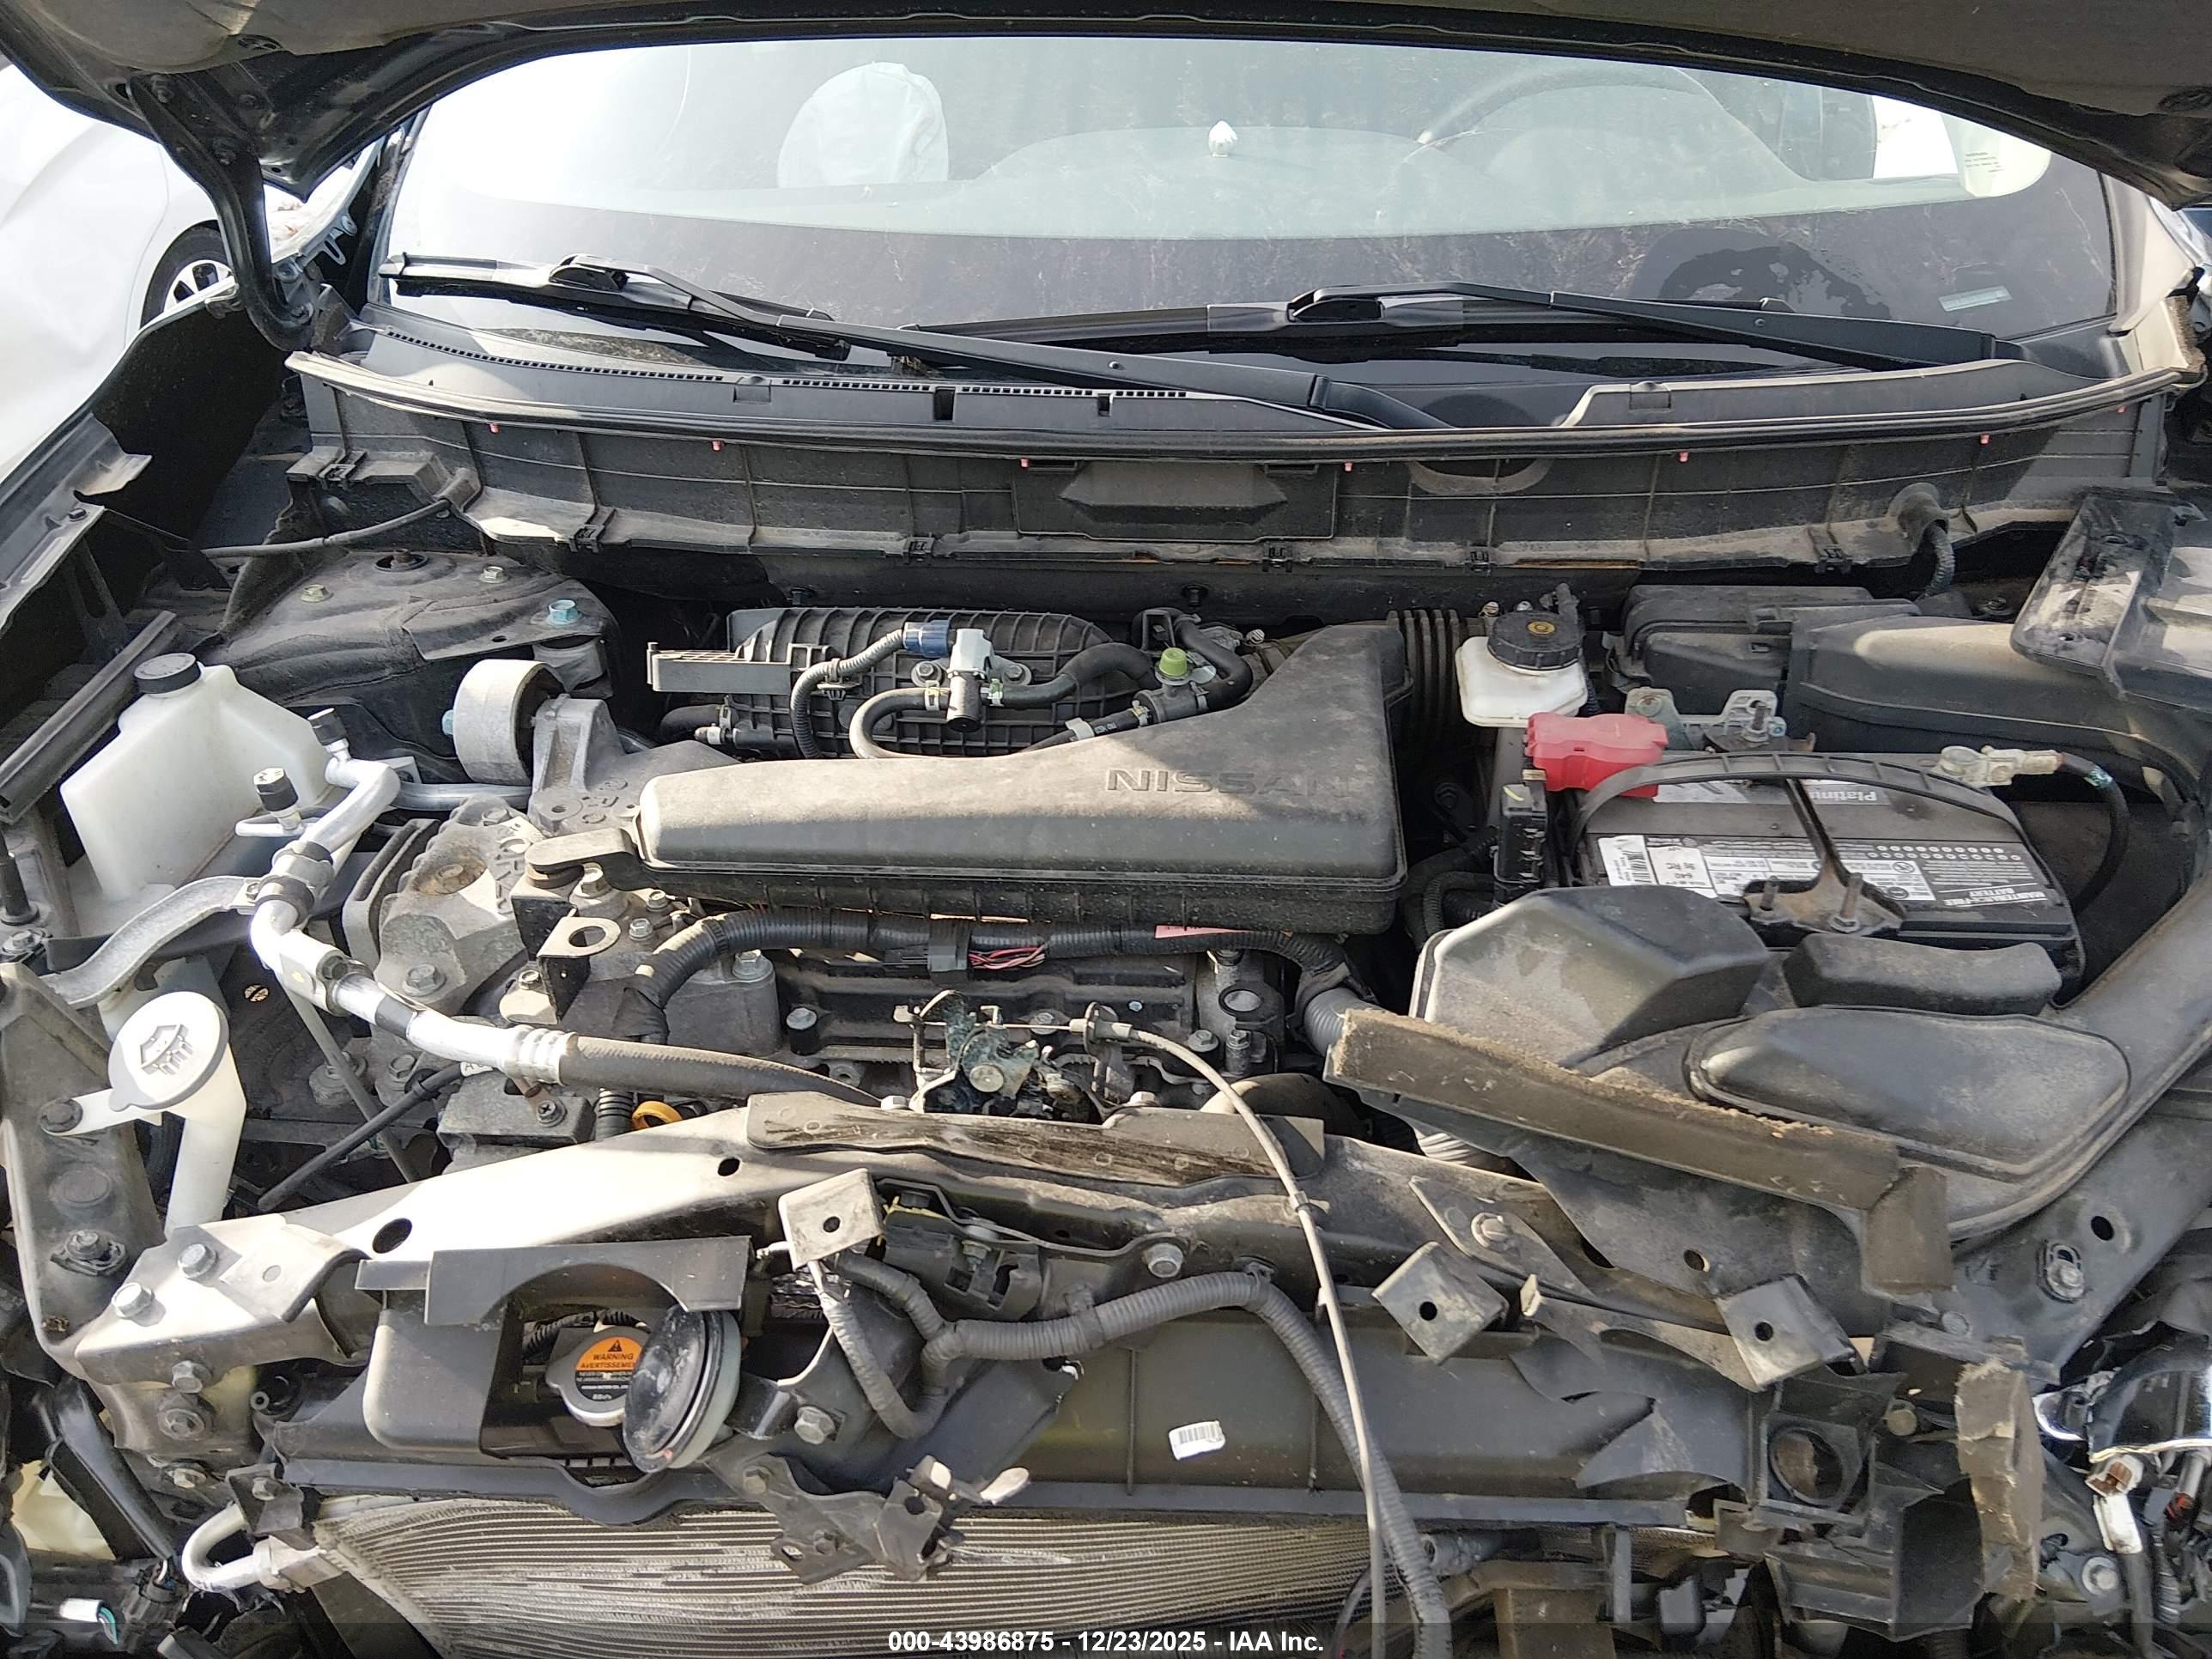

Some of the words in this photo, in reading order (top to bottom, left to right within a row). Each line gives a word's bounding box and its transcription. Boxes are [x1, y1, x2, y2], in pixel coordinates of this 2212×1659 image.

[1106, 769, 1357, 799] NISSAN
[1808, 790, 1878, 801] Platinu
[1969, 886, 2015, 898] BATTERY
[1942, 890, 2047, 907] MAINTENANCE-FREE
[592, 1352, 635, 1361] WARNING
